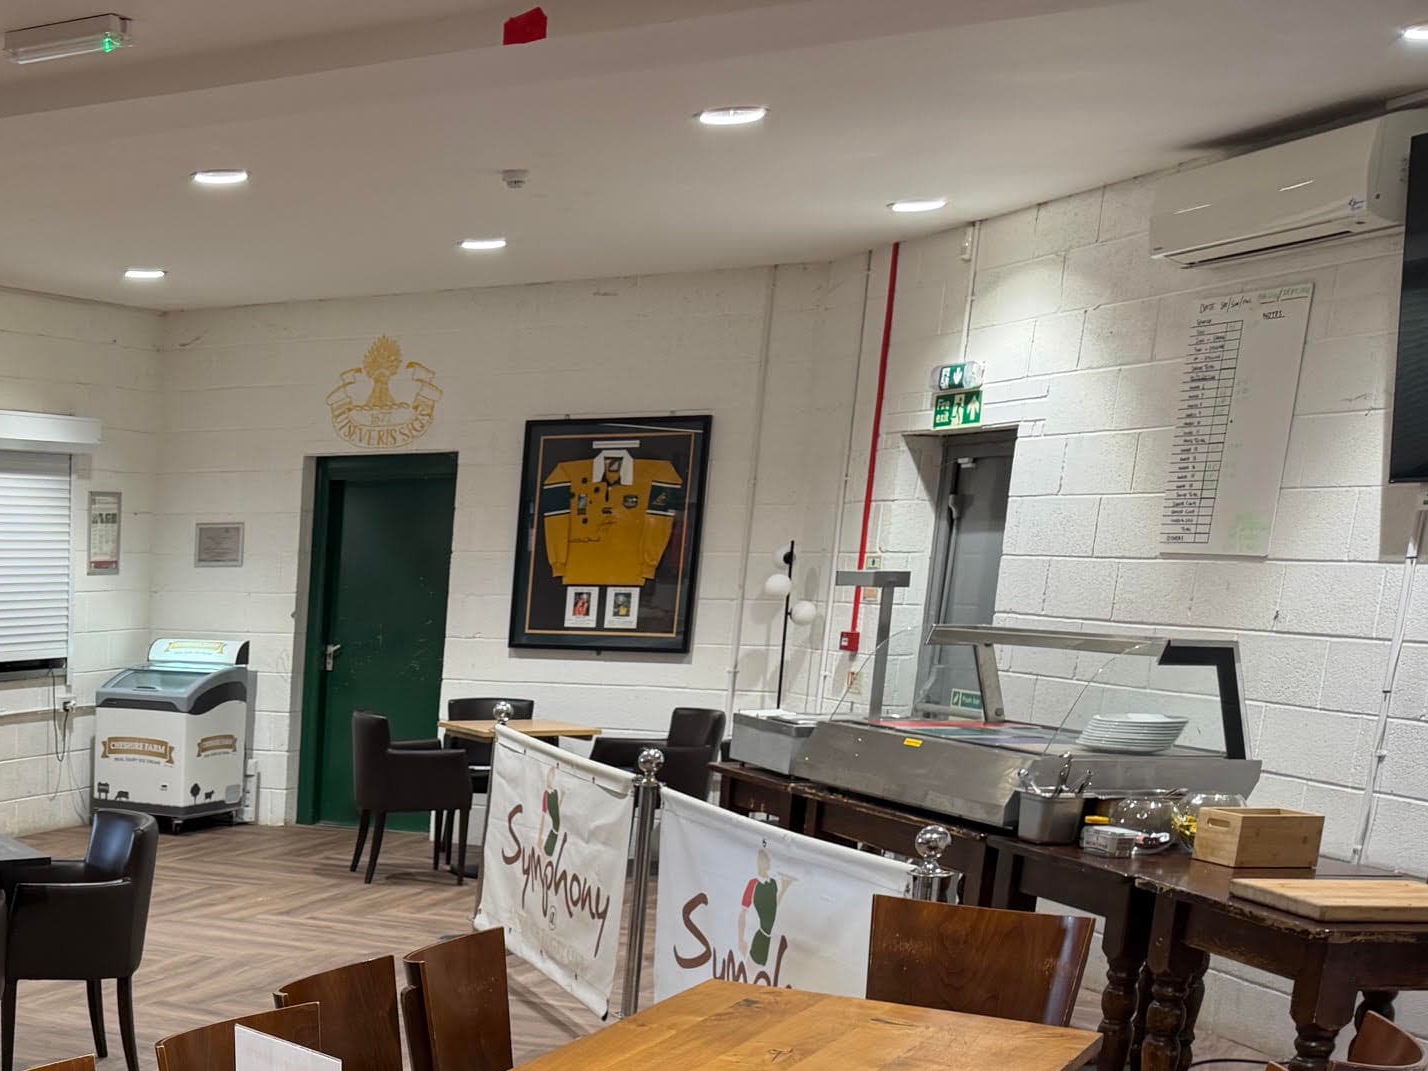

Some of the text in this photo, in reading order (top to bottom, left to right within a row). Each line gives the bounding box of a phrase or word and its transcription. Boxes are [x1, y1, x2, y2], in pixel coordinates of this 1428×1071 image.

[937, 399, 950, 410] Fire
[935, 411, 949, 423] exit
[502, 803, 610, 958] Symphony
